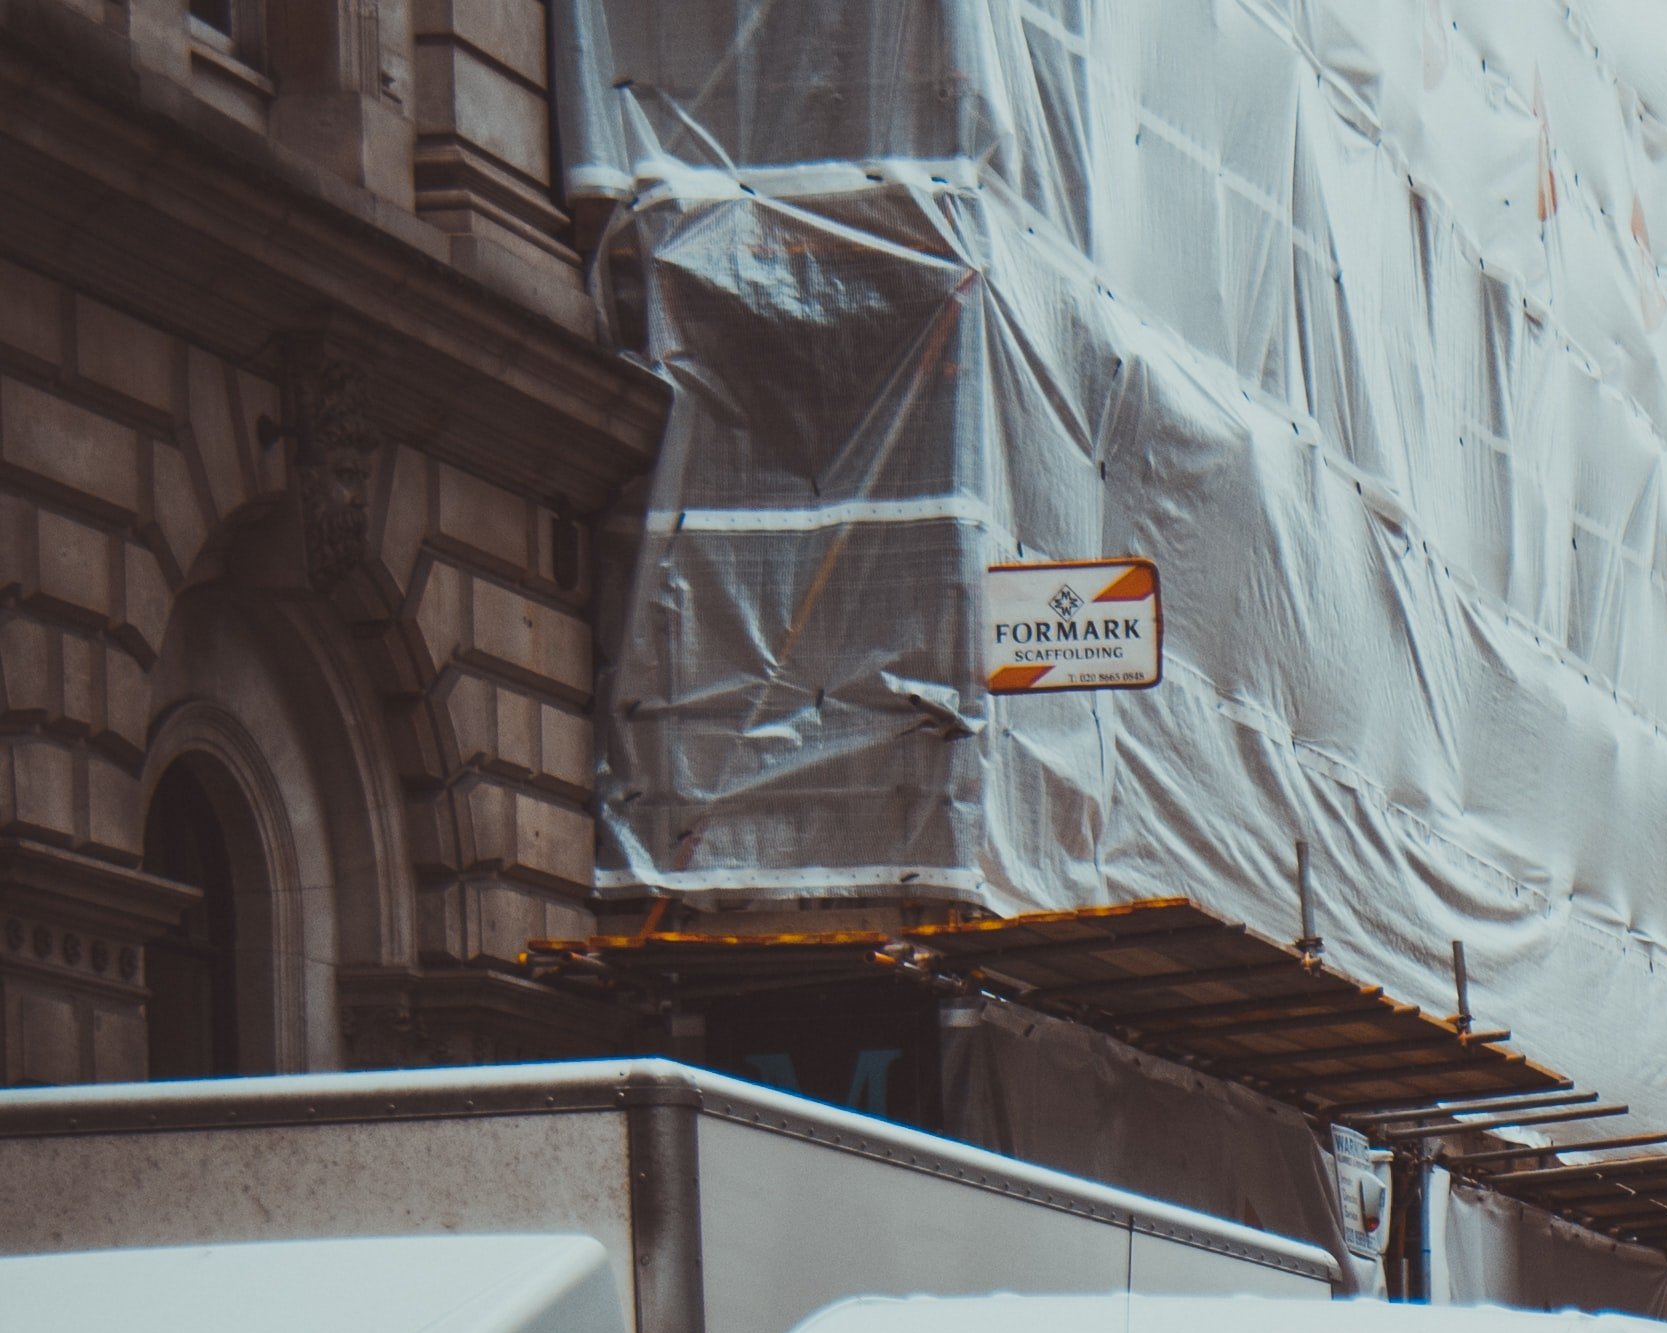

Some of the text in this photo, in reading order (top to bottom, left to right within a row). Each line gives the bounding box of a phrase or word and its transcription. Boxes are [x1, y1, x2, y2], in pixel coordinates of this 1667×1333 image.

[996, 619, 1141, 644] FORMARK
[1015, 647, 1124, 662] SCAFFOLDING
[1080, 672, 1097, 682] 020
